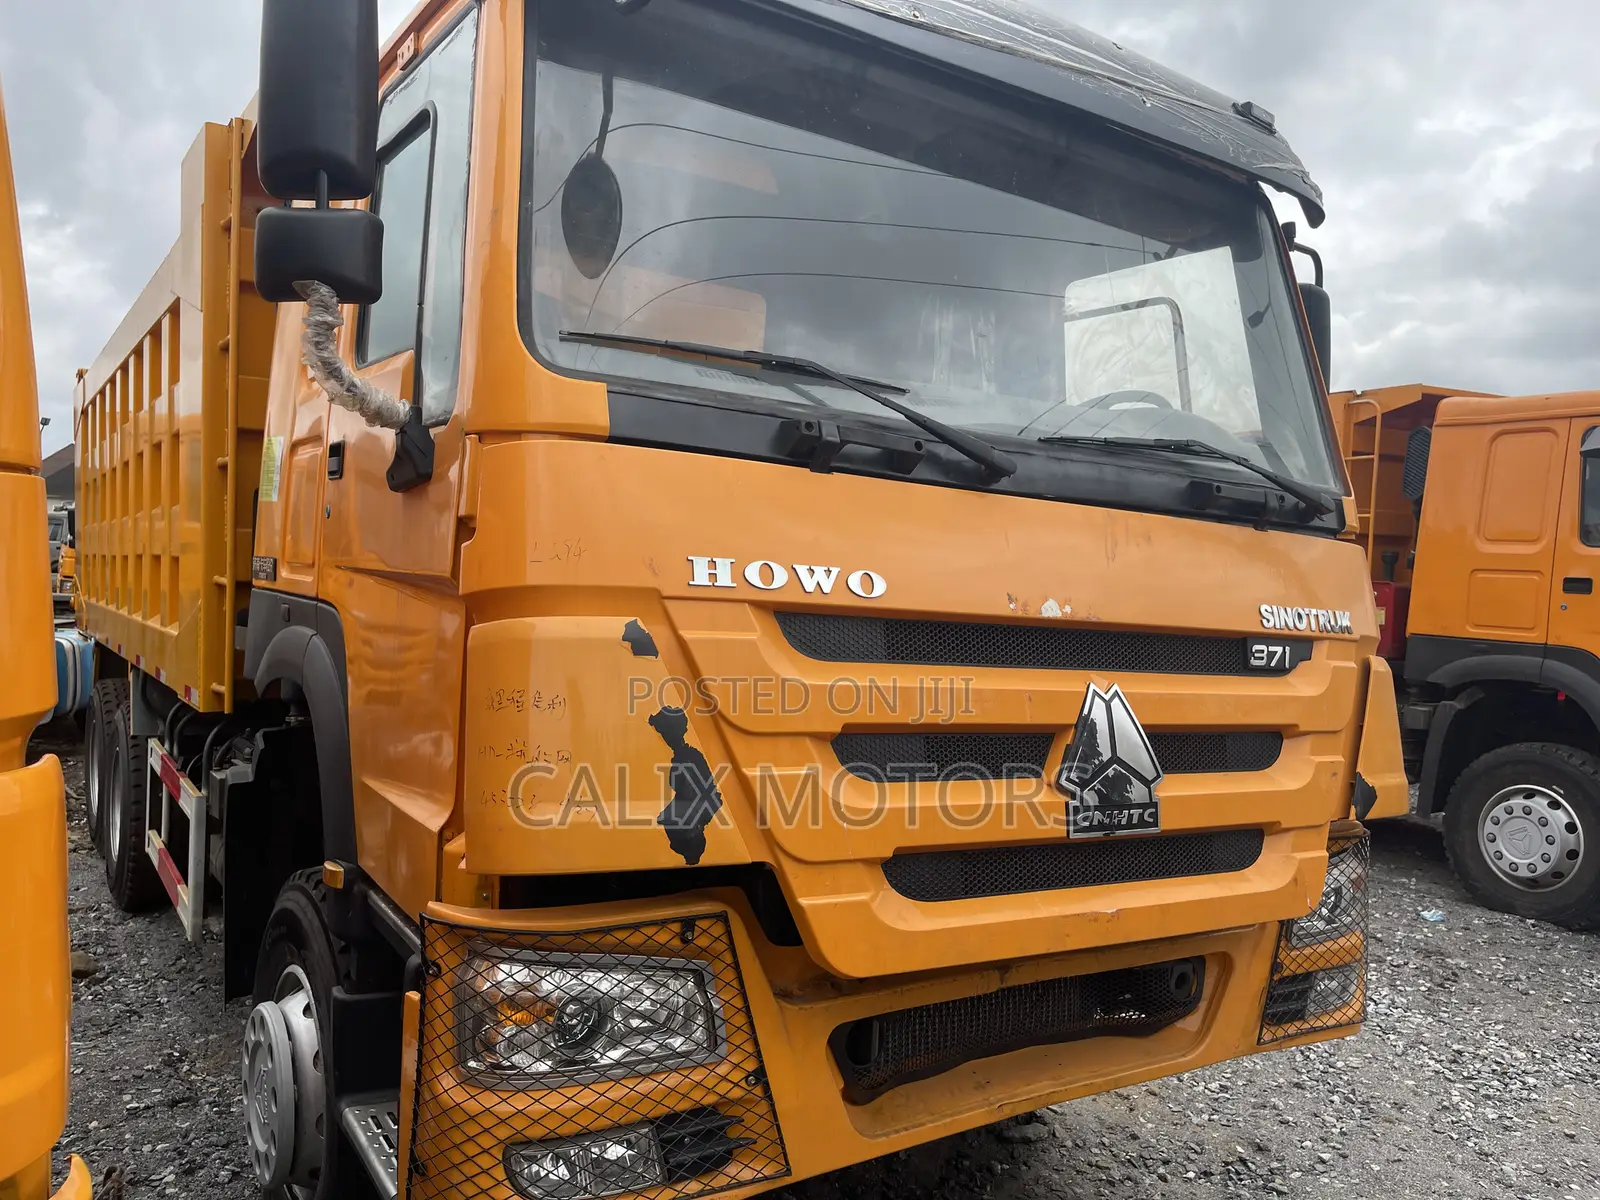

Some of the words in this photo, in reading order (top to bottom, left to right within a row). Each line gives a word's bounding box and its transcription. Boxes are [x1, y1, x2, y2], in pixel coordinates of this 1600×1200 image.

[687, 555, 888, 598] HOWO
[1259, 603, 1353, 634] SINOTRUK
[1250, 645, 1291, 669] 371
[1076, 807, 1156, 827] CNHTC
